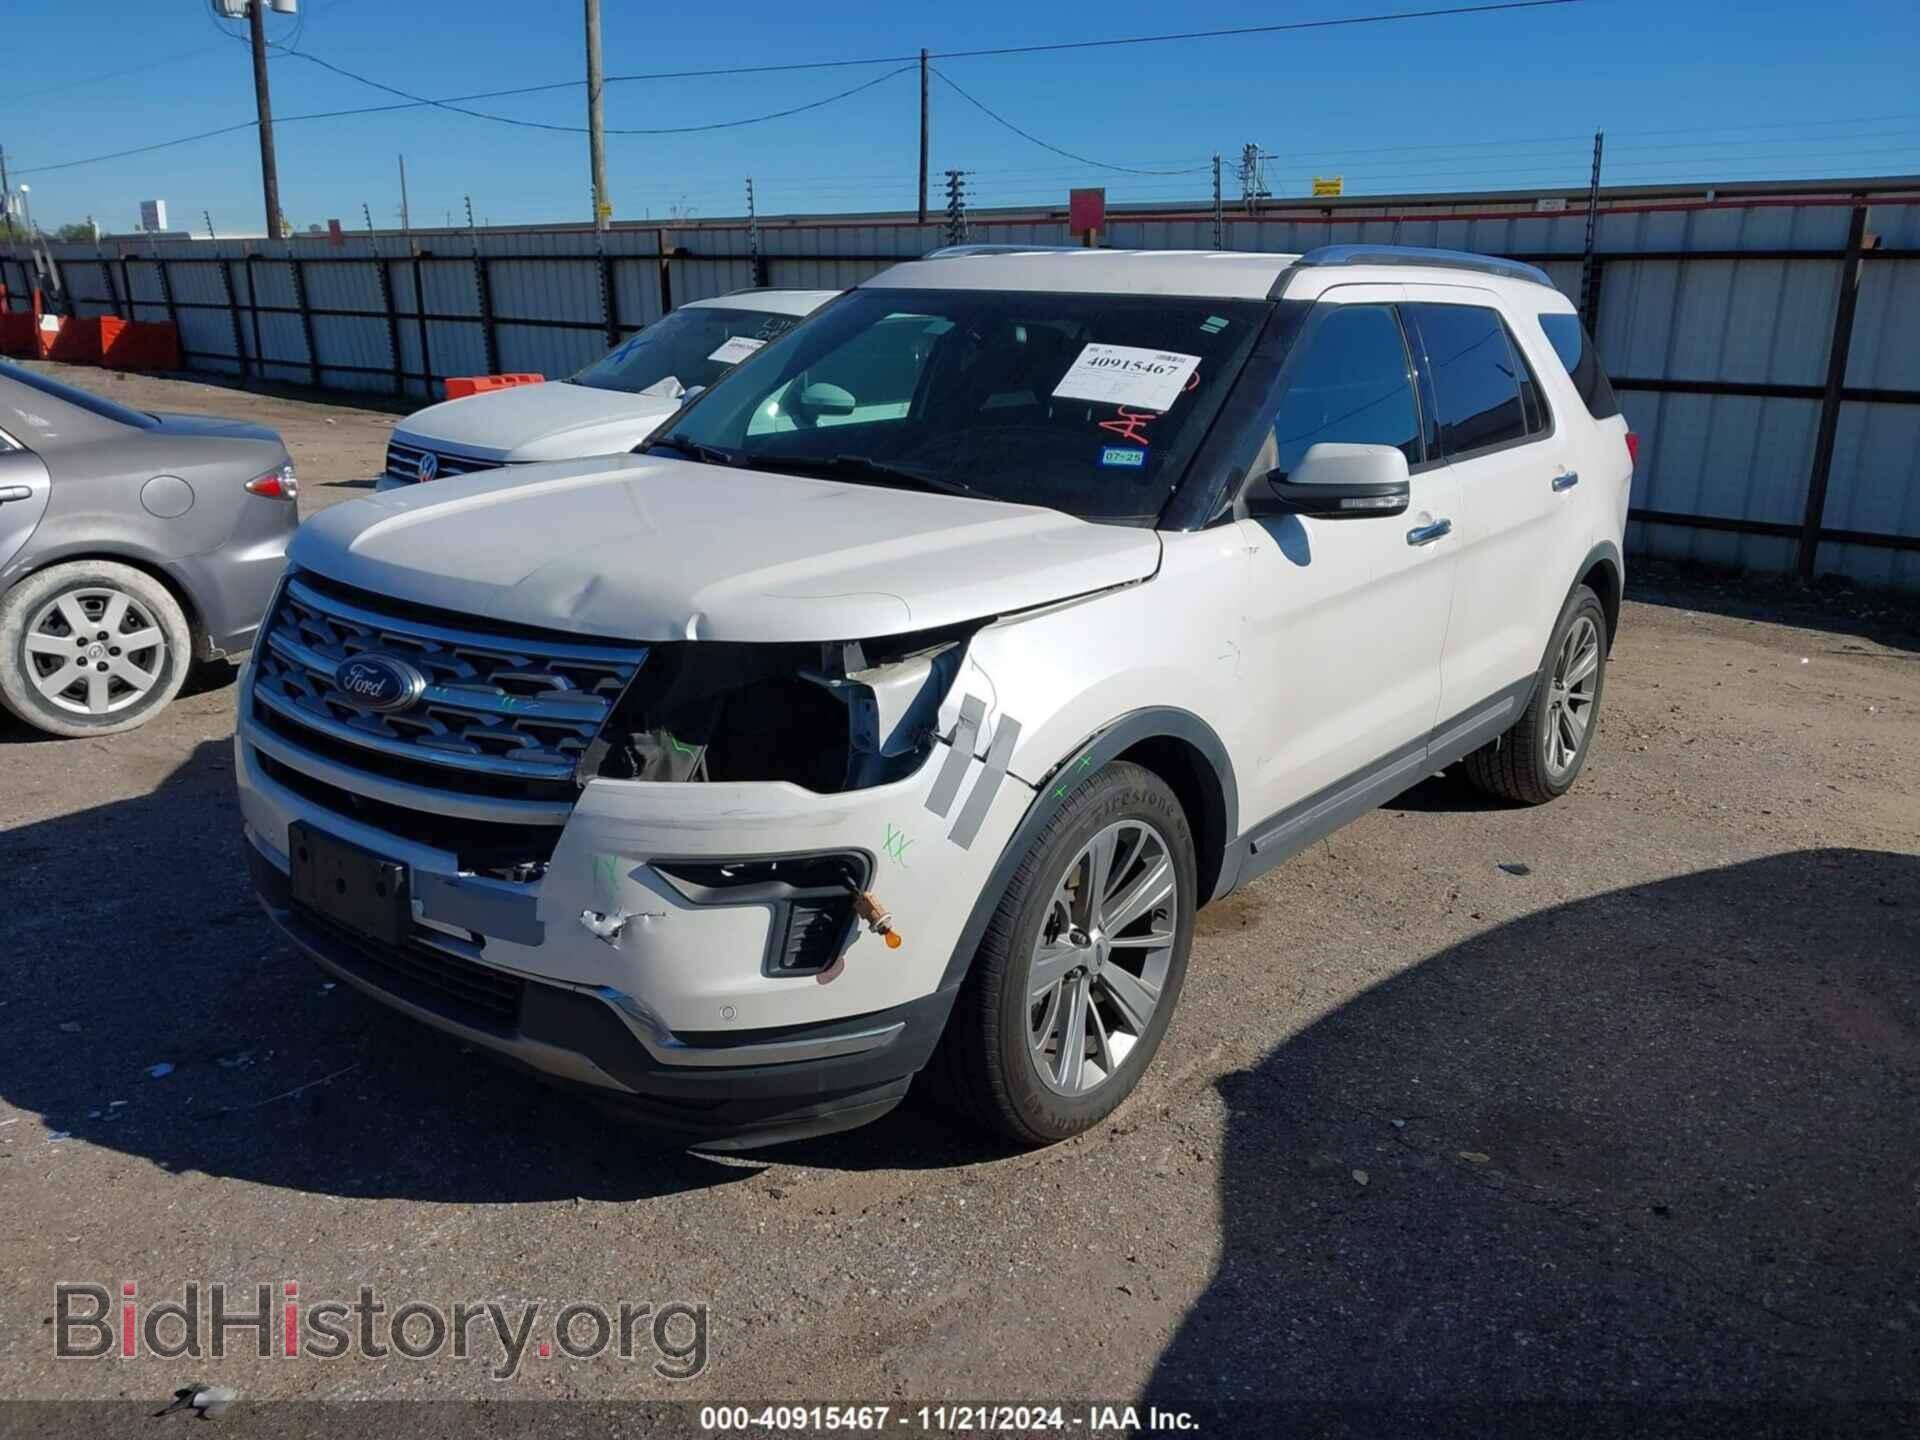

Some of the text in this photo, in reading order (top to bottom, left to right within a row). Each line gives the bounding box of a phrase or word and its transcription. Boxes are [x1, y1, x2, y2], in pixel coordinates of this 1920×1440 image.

[1087, 356, 1179, 377] 40915467
[1105, 452, 1141, 463] 07-25
[344, 664, 386, 697] Ford
